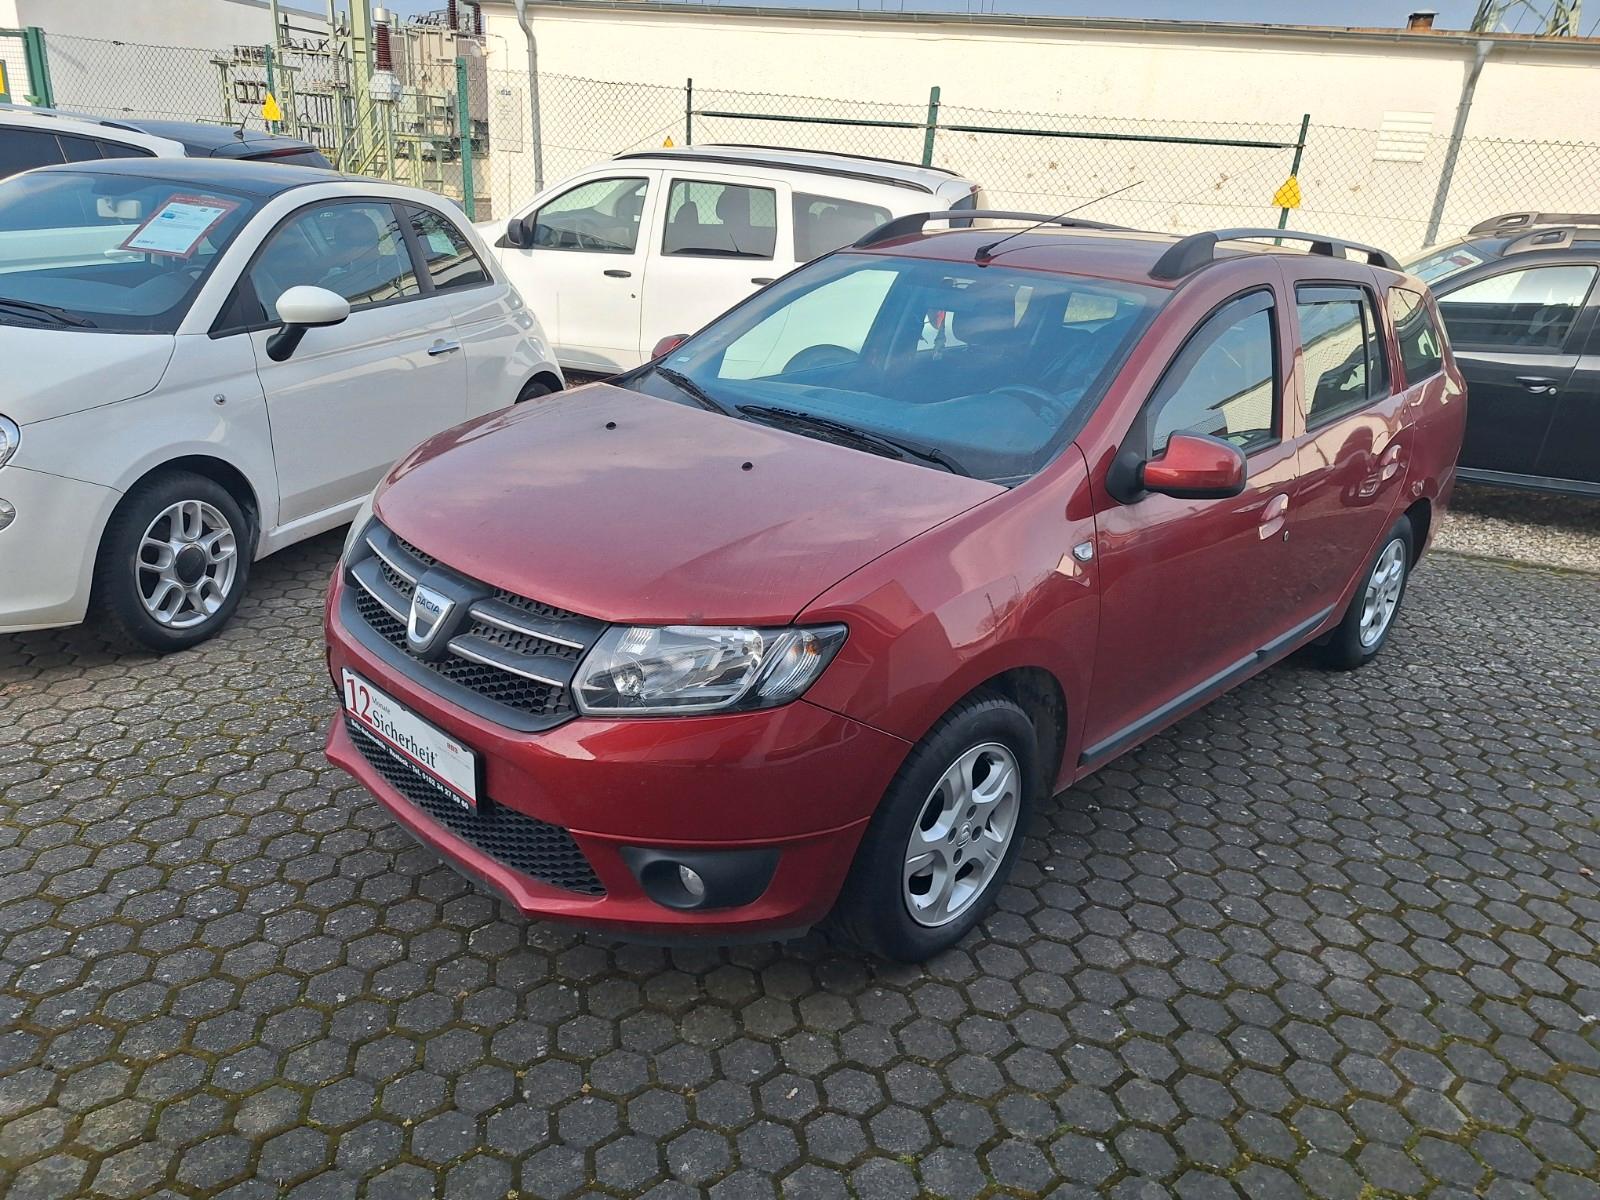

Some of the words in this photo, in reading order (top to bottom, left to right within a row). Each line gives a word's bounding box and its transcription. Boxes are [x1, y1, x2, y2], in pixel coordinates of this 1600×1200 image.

[415, 595, 440, 614] DACIA
[346, 678, 372, 724] 12
[372, 710, 435, 769] Sicherheit
